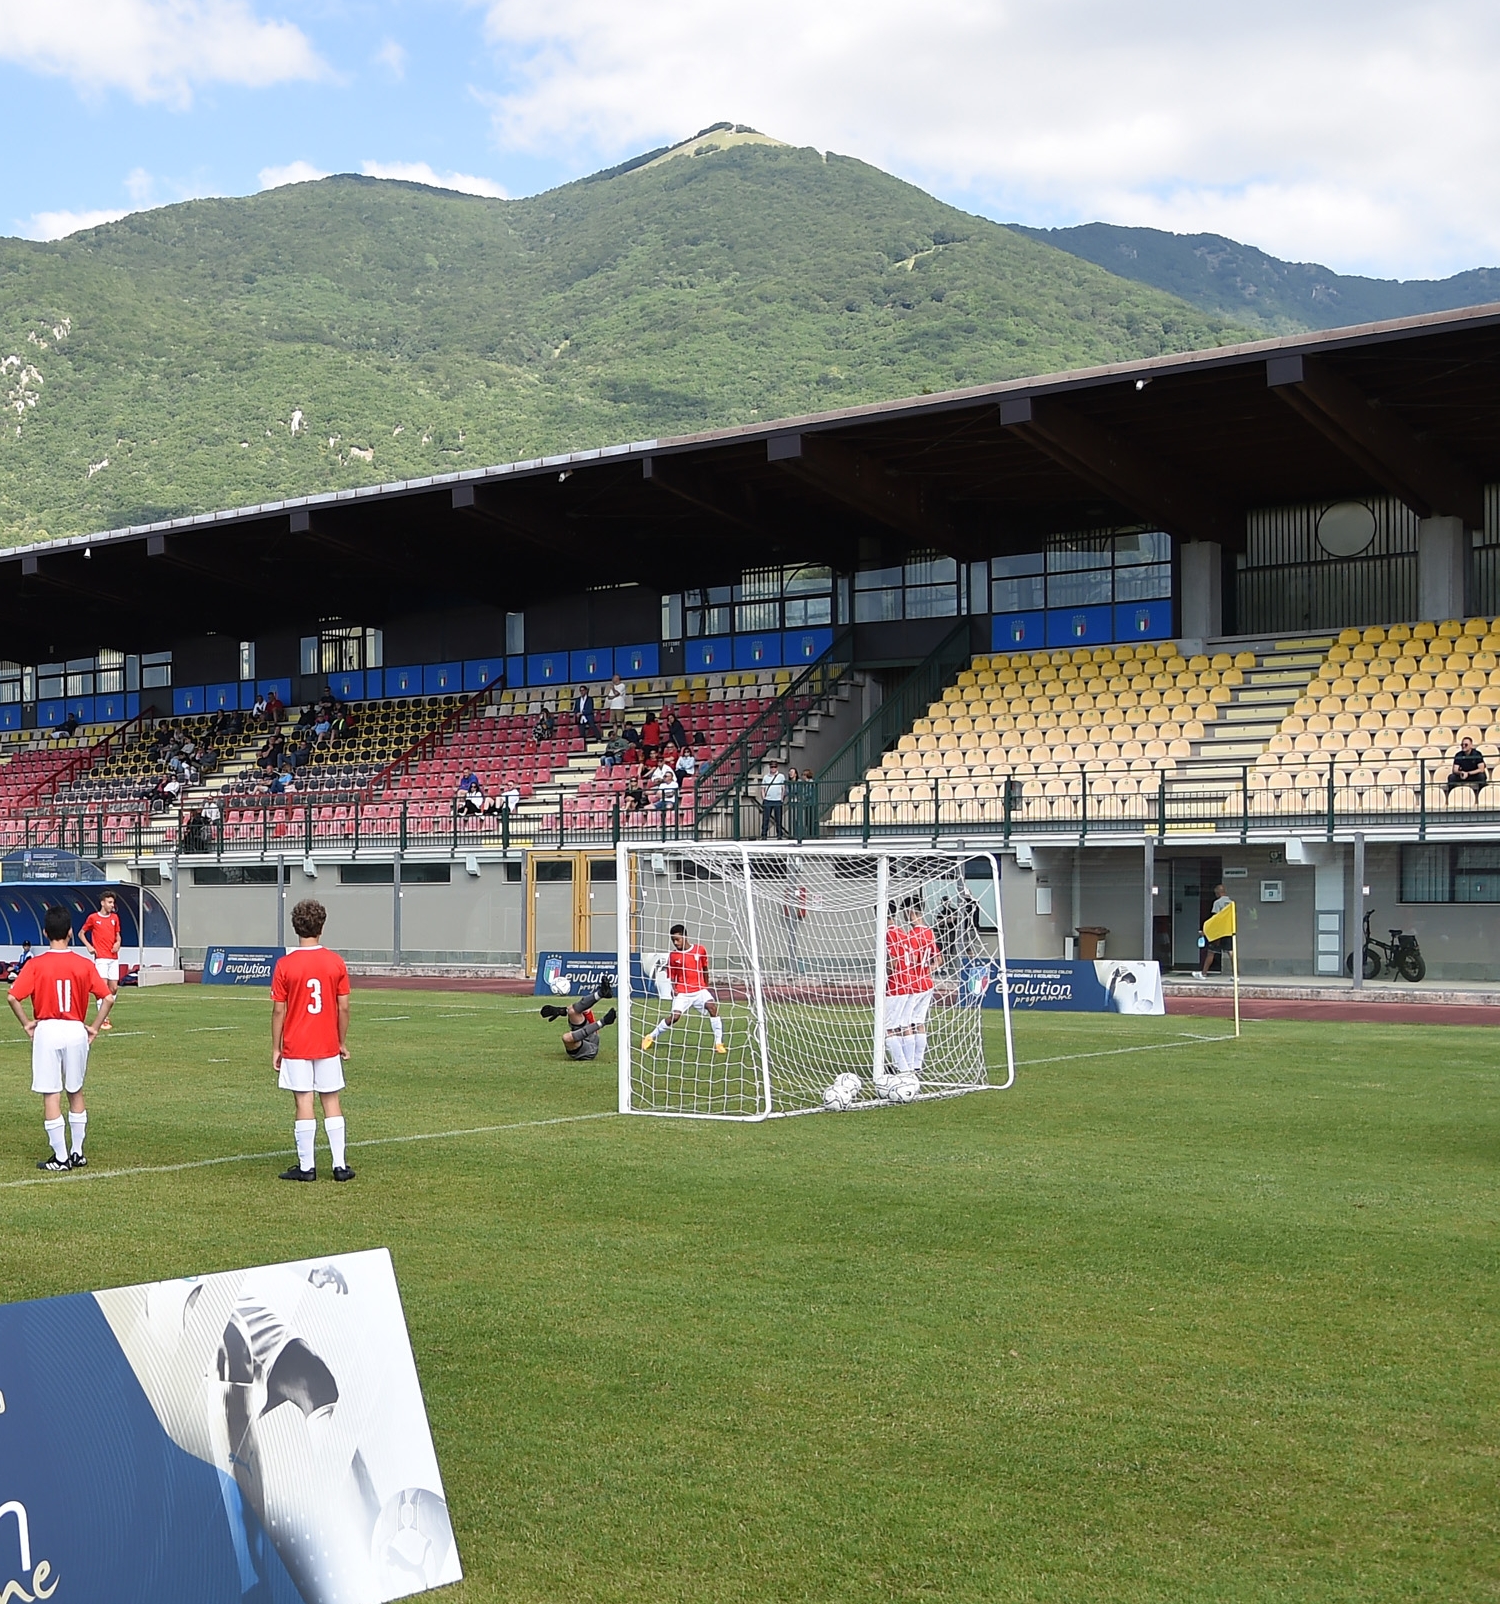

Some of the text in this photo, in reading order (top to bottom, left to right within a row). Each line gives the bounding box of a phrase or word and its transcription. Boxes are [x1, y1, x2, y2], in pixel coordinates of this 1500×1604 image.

[225, 963, 271, 974] evolution
[56, 979, 71, 1013] 11
[306, 978, 322, 1014] 3
